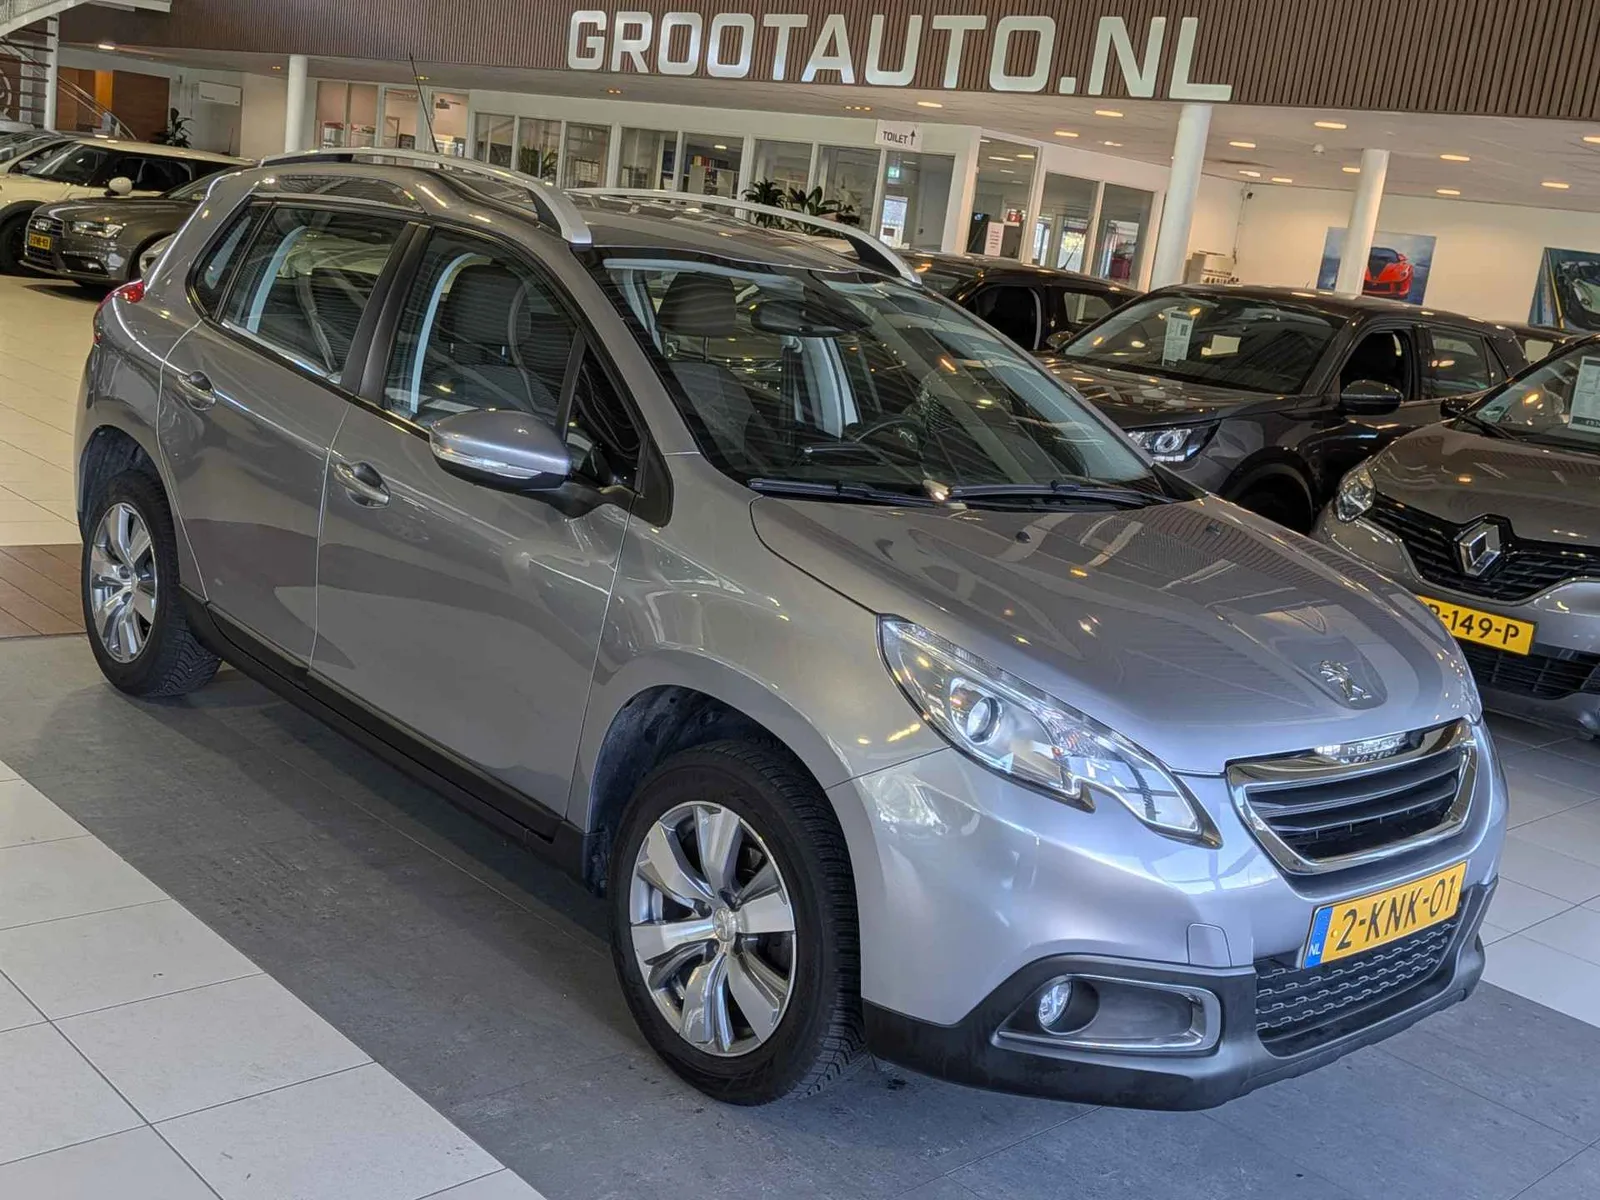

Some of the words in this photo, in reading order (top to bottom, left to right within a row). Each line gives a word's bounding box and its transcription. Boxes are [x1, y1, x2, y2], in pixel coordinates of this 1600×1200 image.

[567, 10, 1233, 102] GROOTAUTO.NL
[882, 130, 909, 145] TOILET
[1335, 875, 1456, 952] 2-KNK-01
[1308, 942, 1321, 956] NL
